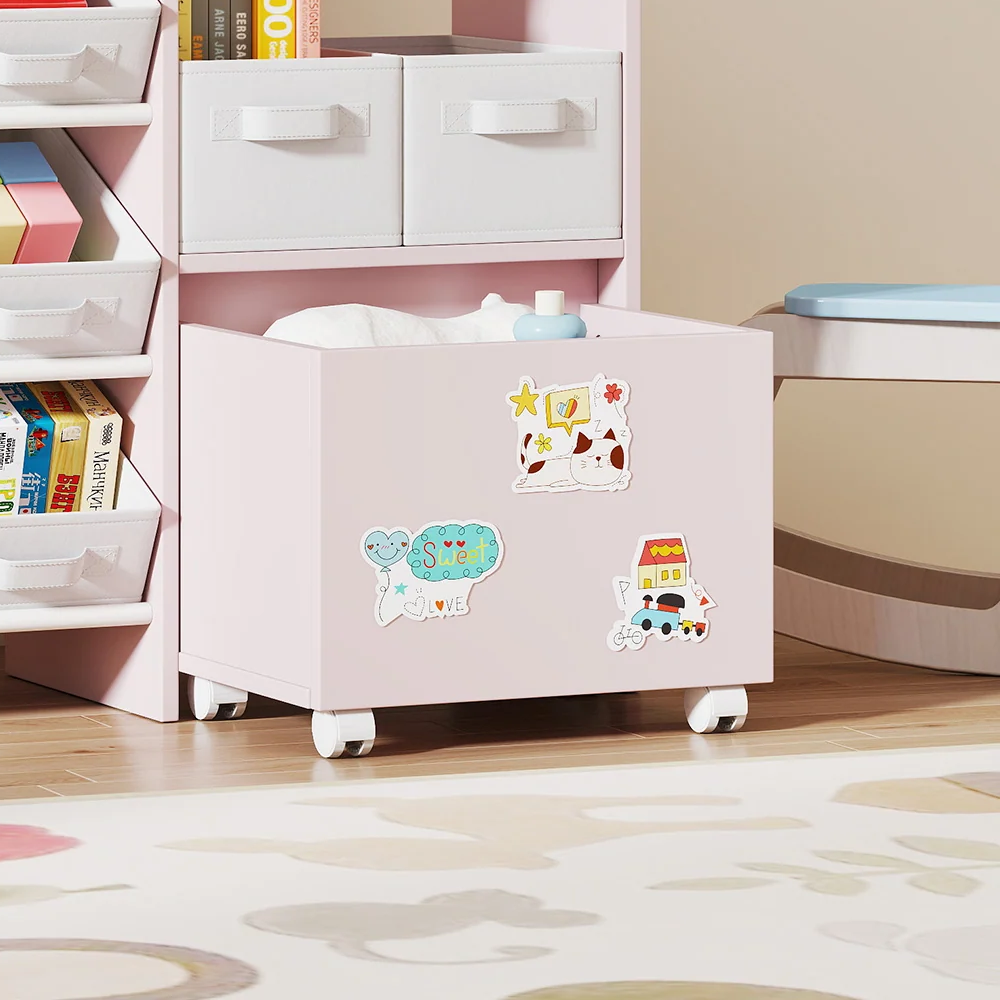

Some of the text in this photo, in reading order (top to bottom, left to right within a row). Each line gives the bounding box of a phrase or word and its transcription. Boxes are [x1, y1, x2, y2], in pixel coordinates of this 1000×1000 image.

[214, 8, 225, 38] ARNE
[236, 12, 247, 40] EERO
[50, 473, 81, 513] БЭНГ
[422, 537, 489, 569] Sweet
